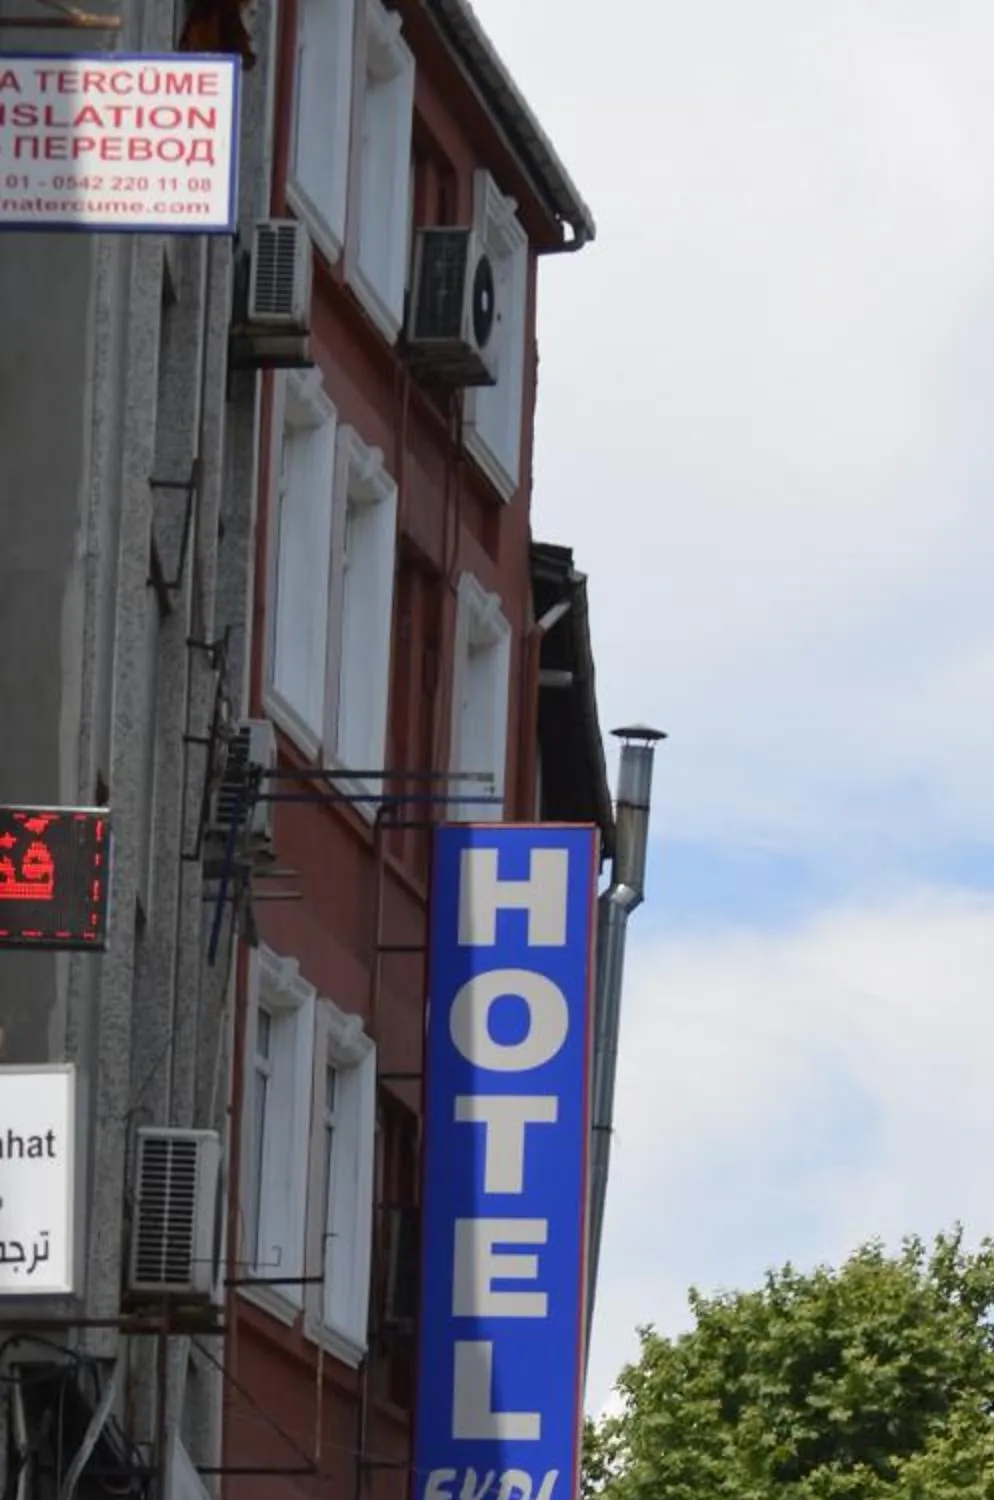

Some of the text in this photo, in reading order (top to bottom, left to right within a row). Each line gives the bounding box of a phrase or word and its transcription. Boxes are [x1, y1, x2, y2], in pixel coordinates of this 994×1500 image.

[34, 66, 219, 96] TERCÜME
[0, 103, 217, 129] SLATION
[13, 135, 215, 166] ПЕРЕВОД
[52, 175, 104, 192] 0542
[110, 176, 149, 192] 220
[157, 177, 178, 192] 11
[187, 177, 212, 194] 08
[0, 1128, 56, 1159] hat
[449, 846, 570, 1441] HOTEL
